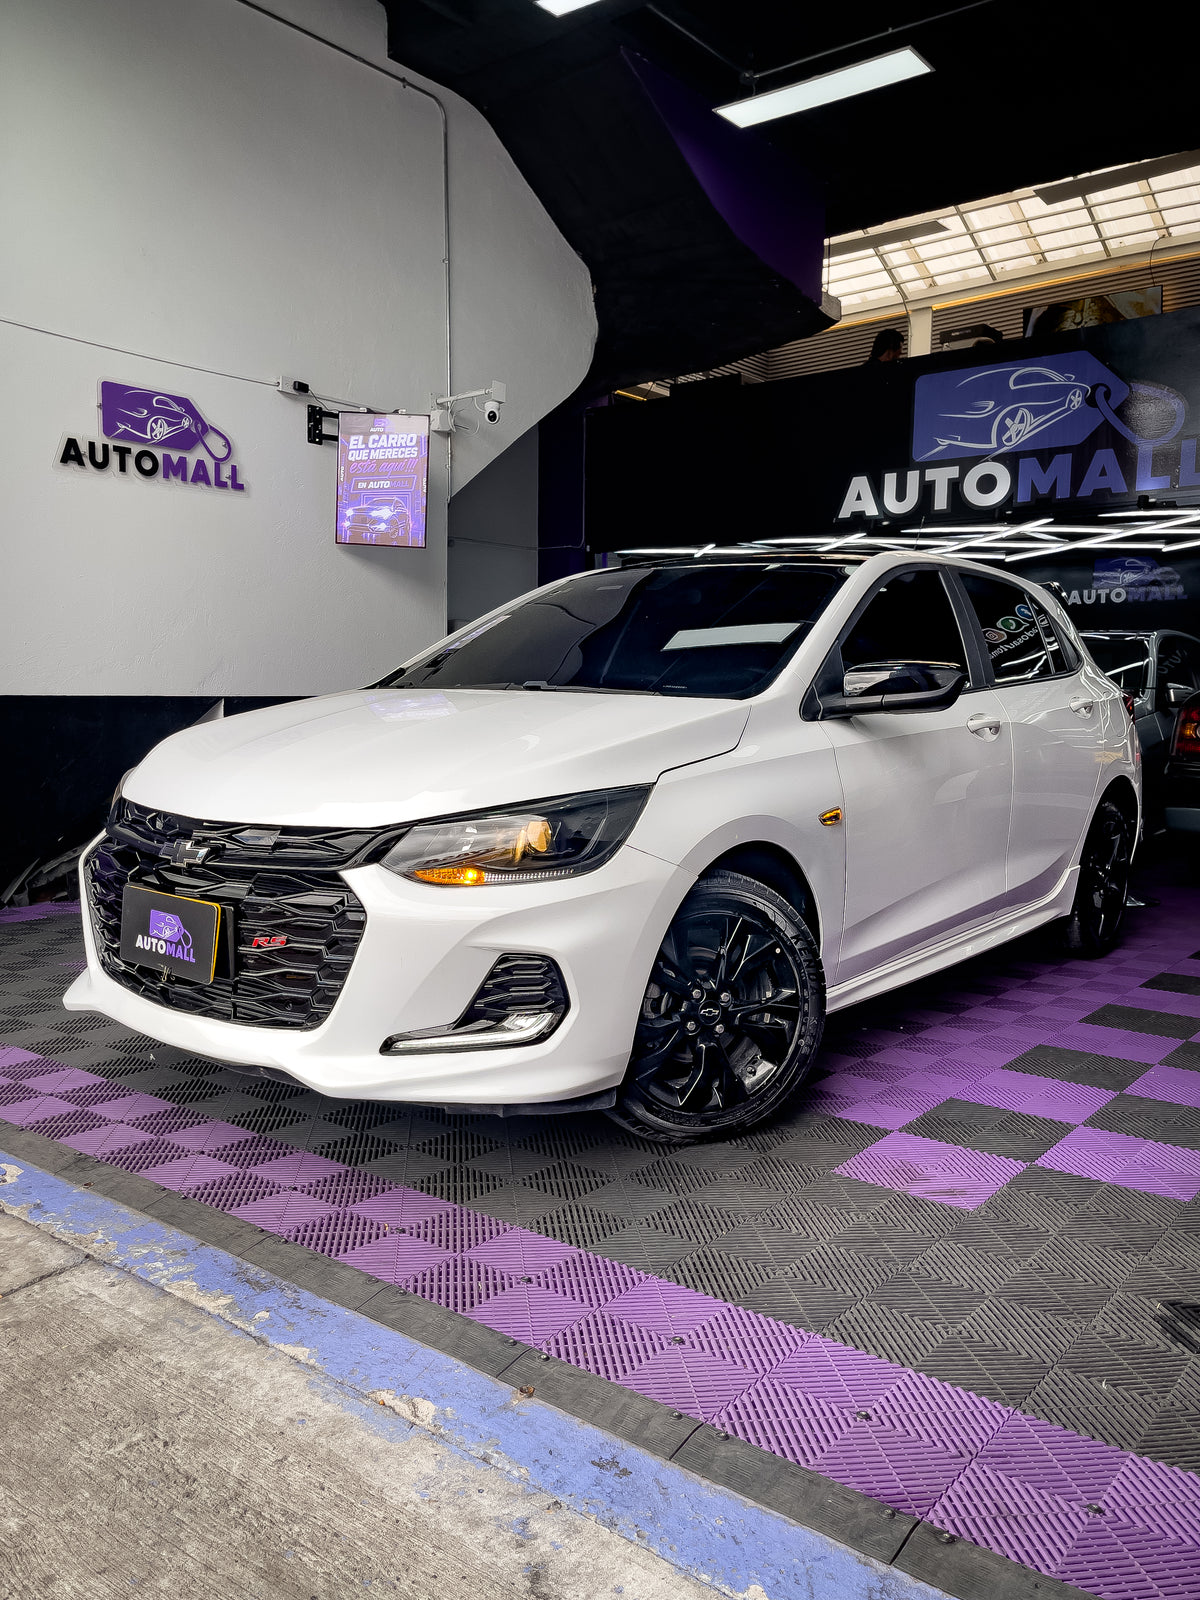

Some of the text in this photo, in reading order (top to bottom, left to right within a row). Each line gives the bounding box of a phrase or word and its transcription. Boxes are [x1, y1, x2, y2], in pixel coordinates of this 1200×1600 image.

[348, 432, 418, 450] EL CARRO
[347, 447, 419, 461] QUE MERECES
[60, 437, 245, 491] AUTOMALL
[349, 459, 377, 474] está
[357, 481, 367, 489] EN
[135, 934, 196, 963] AUTOMALL
[251, 935, 288, 948] RS
